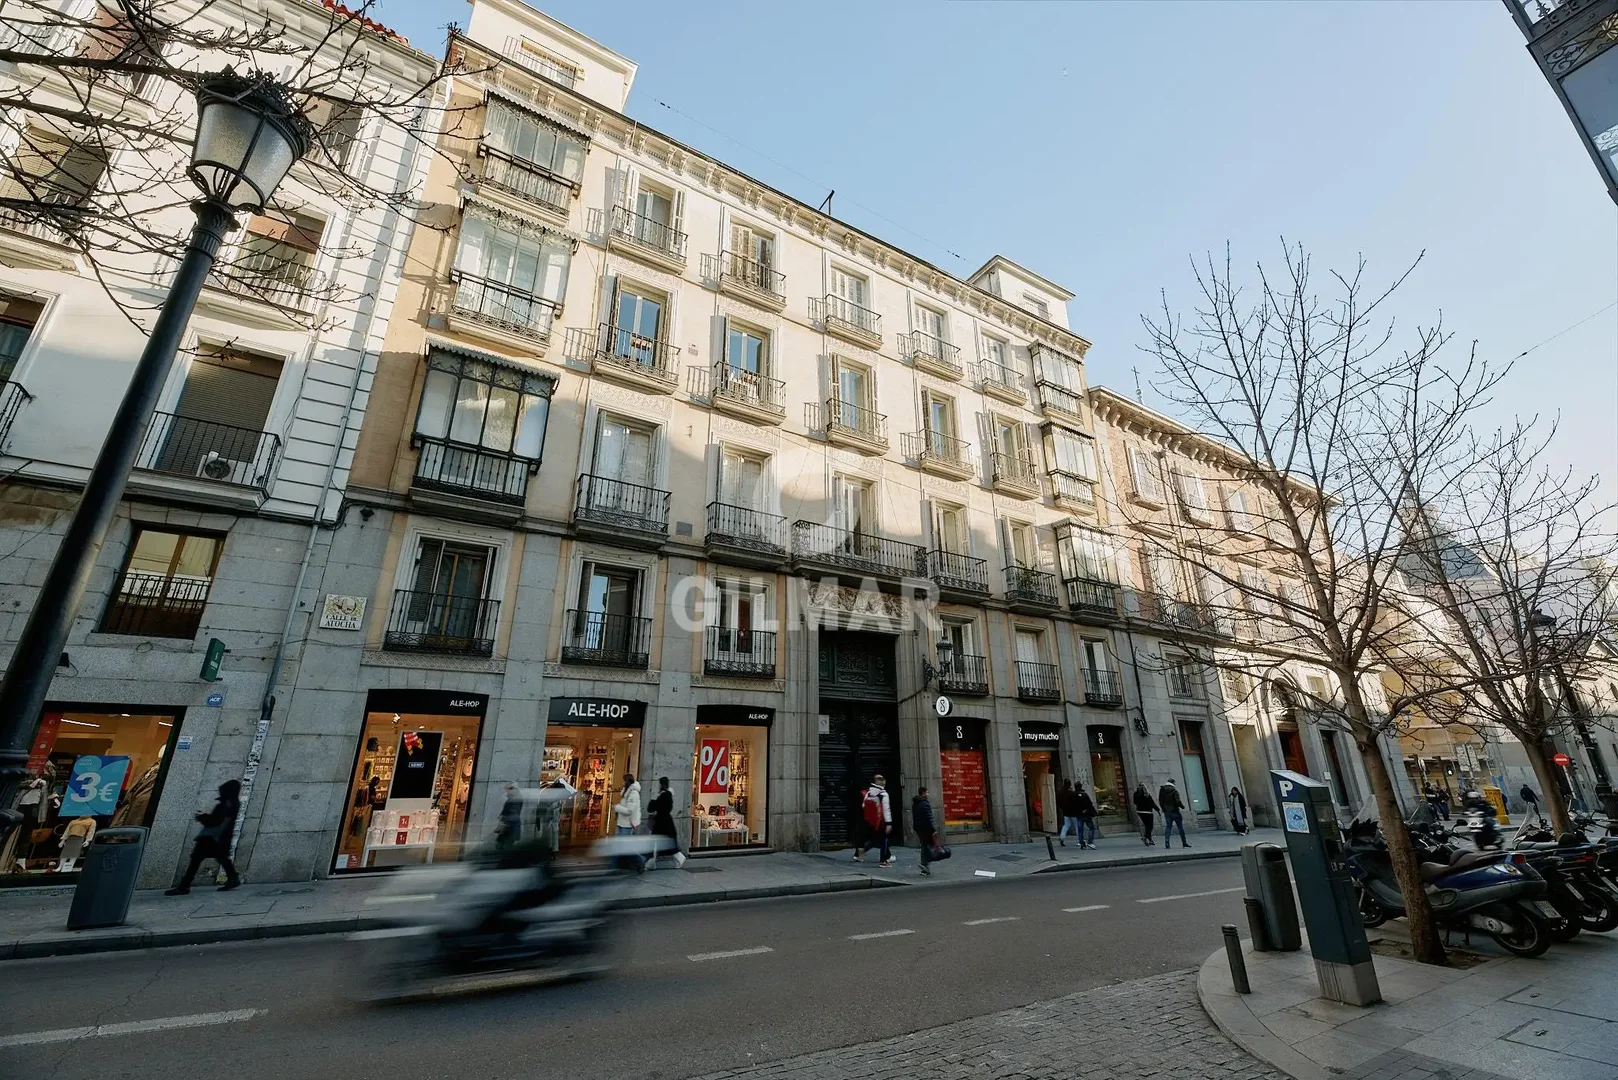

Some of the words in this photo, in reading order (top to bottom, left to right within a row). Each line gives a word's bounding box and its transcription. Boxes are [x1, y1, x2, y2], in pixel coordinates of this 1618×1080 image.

[449, 699, 480, 708] ALE-HOP
[567, 702, 630, 718] ALE-HOP
[1024, 733, 1038, 741] muy
[1038, 732, 1060, 741] mucho
[71, 772, 117, 802] 3€
[1278, 780, 1294, 797] P
